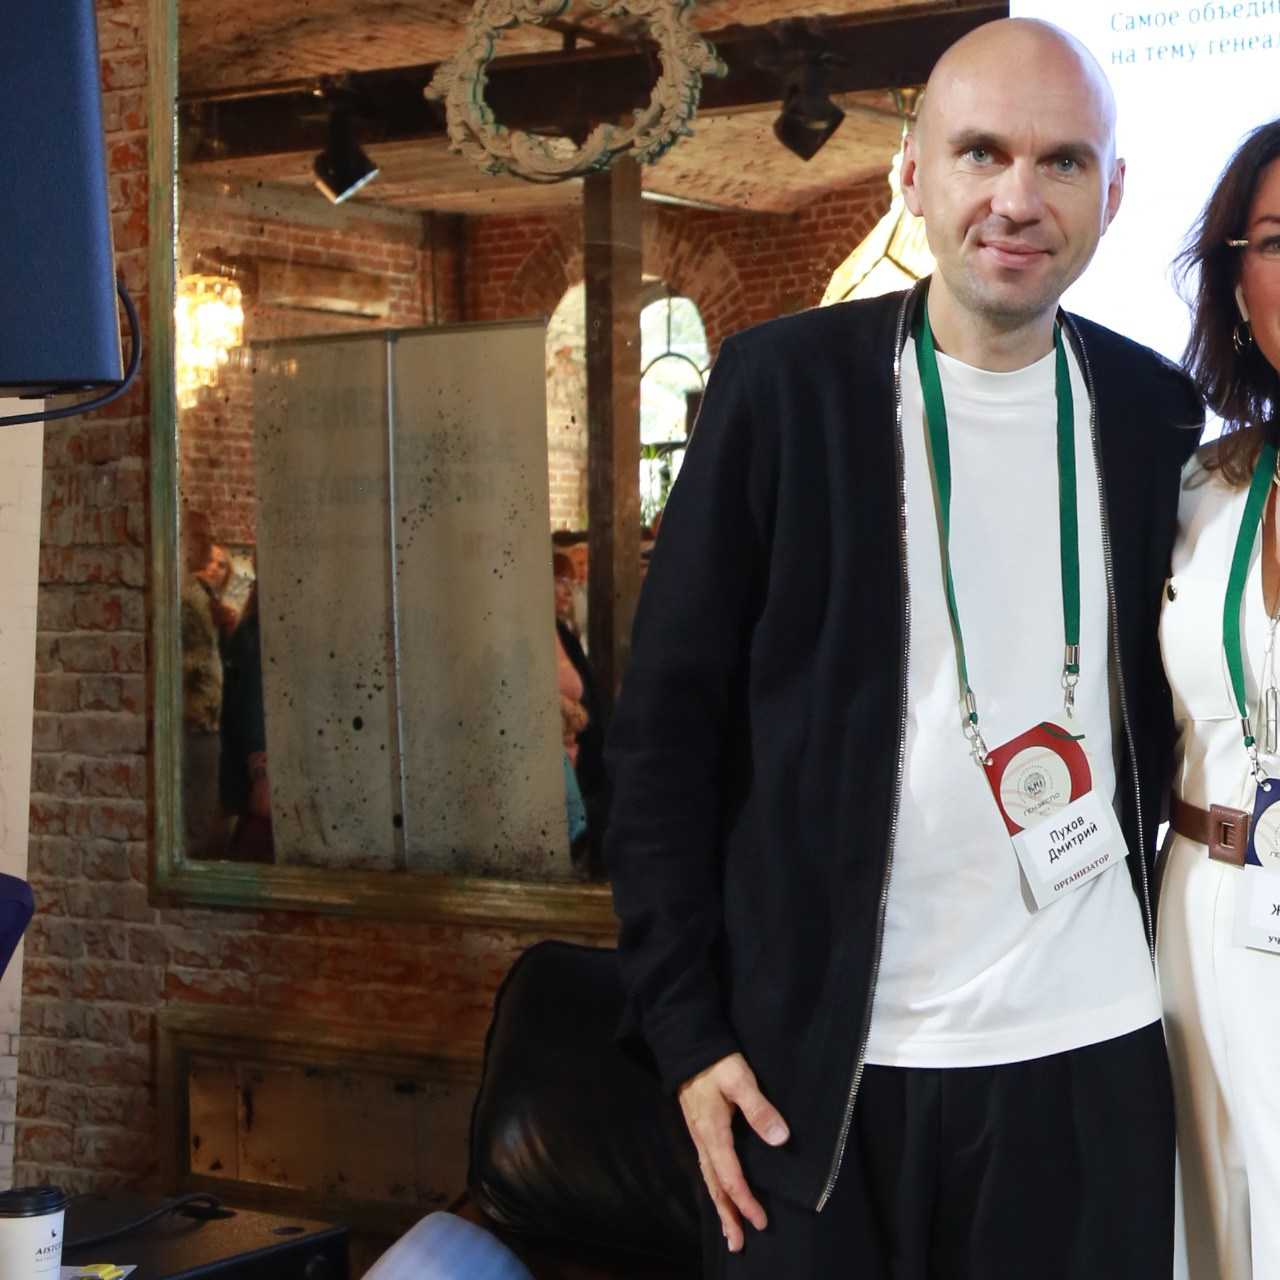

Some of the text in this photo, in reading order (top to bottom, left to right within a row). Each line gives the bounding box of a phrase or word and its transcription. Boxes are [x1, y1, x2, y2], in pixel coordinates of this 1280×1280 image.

[1110, 10, 1180, 32] Самое
[1111, 48, 1136, 65] на
[1146, 42, 1197, 62] тему
[1048, 821, 1098, 864] Дмитрий
[1049, 816, 1085, 843] Пухов
[1053, 853, 1110, 892] ОРГАНИЗАТОР
